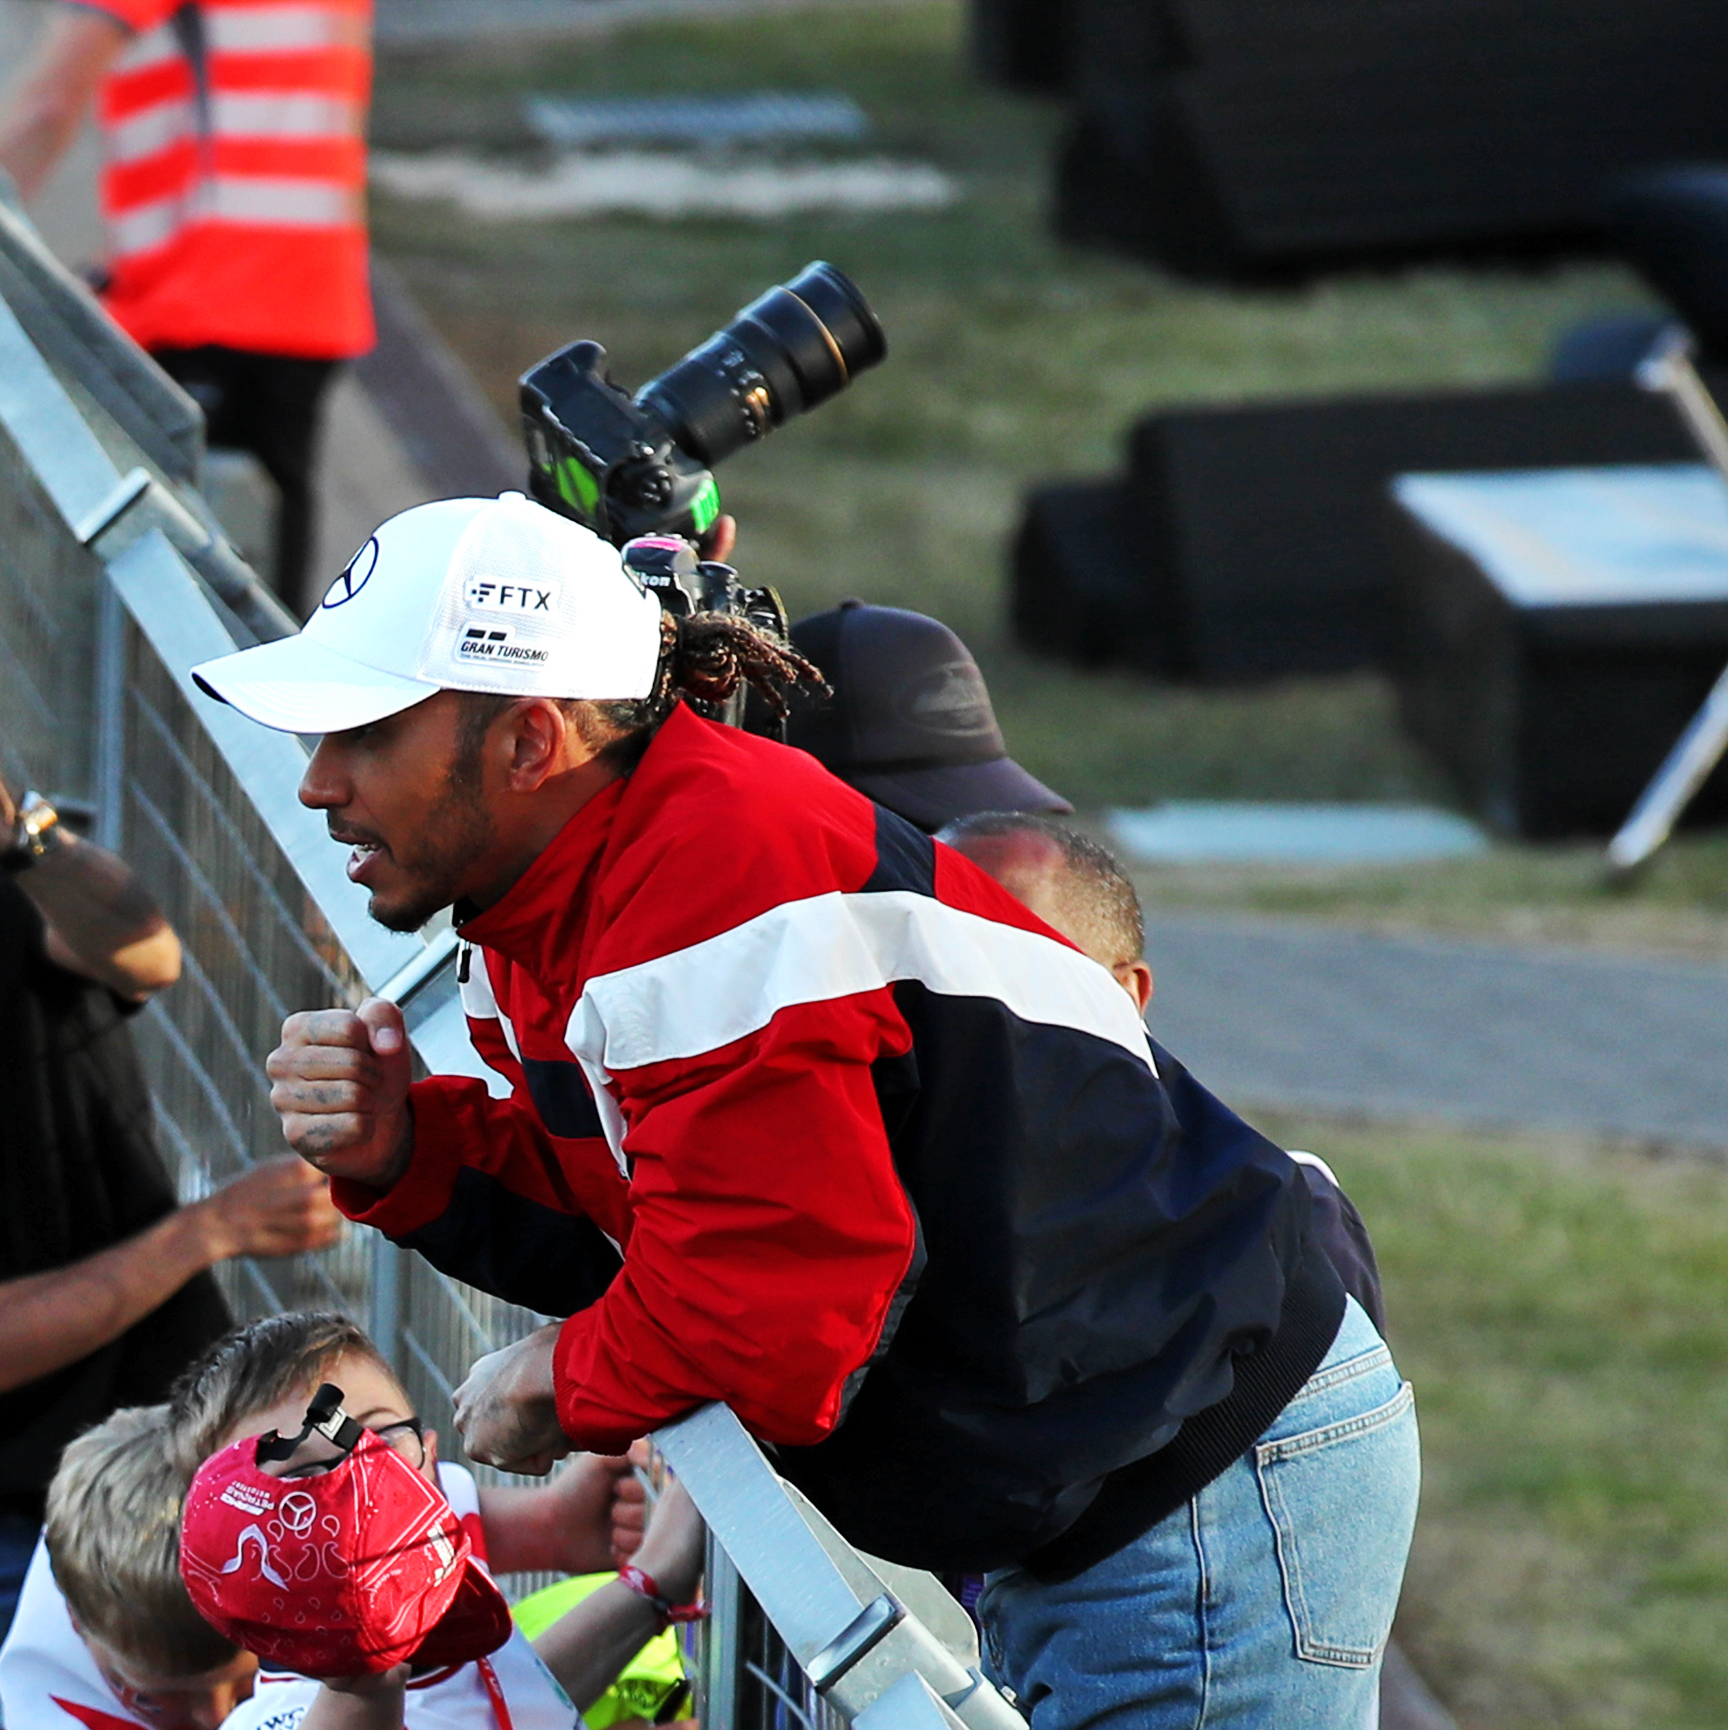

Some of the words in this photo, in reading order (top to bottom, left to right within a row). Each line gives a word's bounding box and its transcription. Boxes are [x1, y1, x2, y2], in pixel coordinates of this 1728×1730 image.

[499, 585, 552, 611] FTX
[460, 640, 494, 657] GRAN
[496, 644, 550, 663] TURISMO
